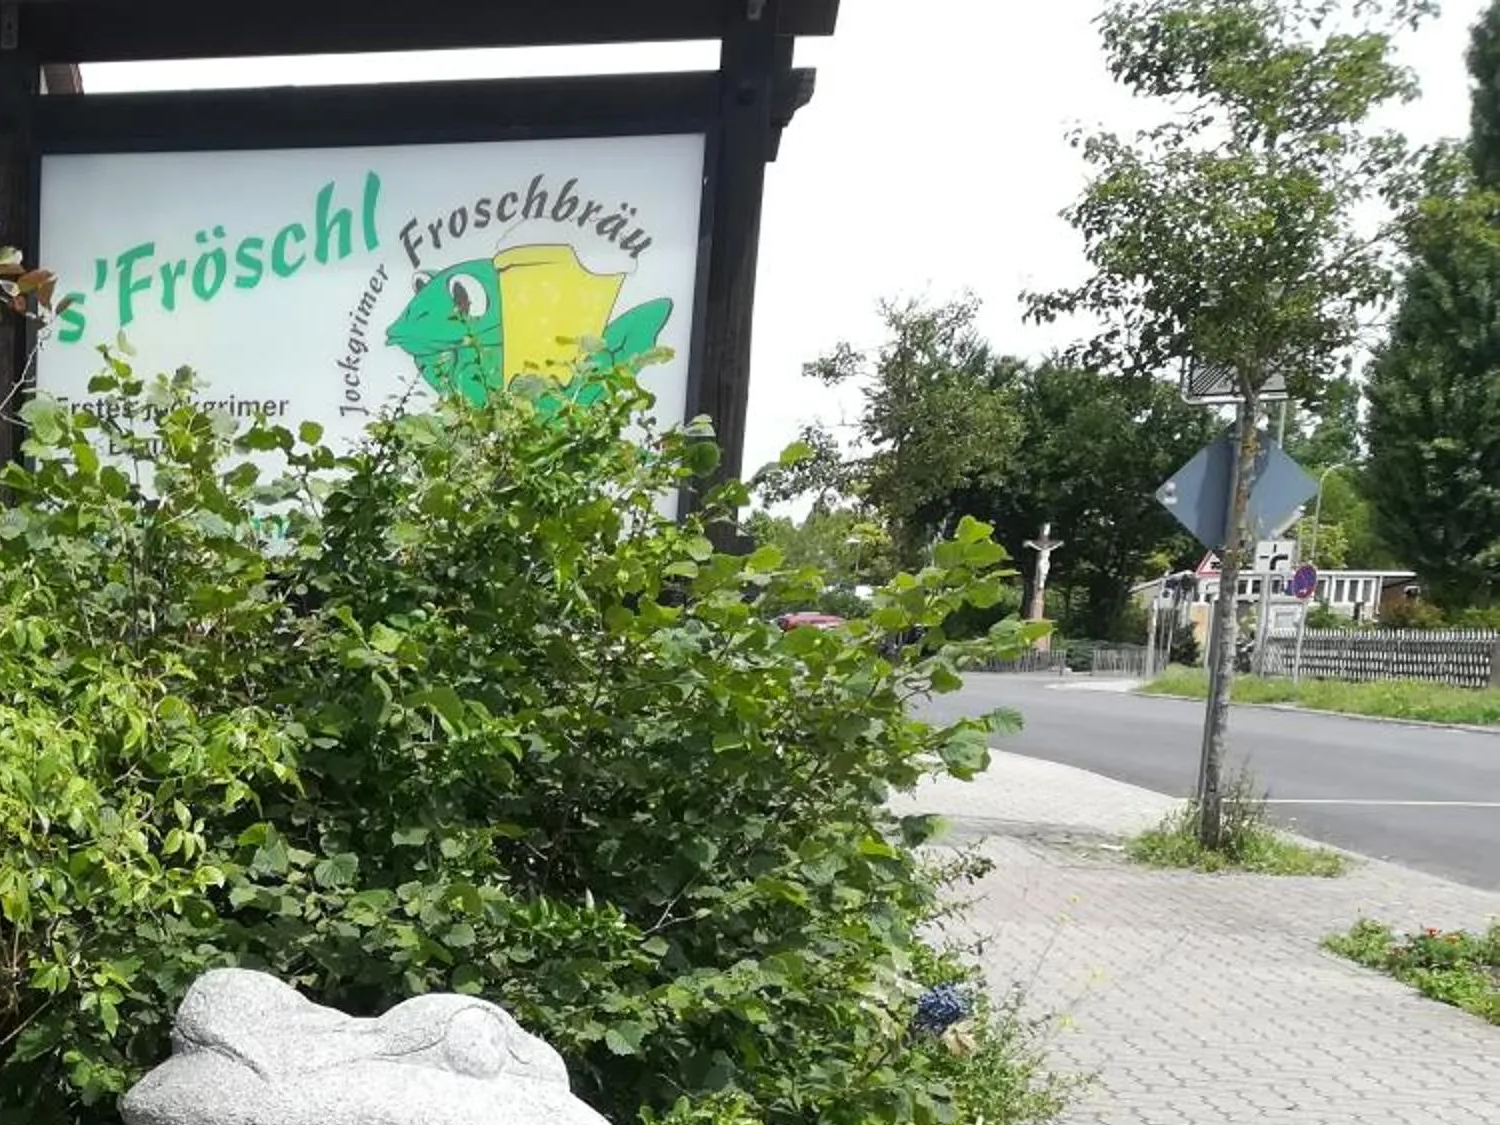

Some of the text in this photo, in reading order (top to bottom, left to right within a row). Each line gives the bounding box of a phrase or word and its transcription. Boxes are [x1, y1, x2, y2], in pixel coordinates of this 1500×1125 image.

[338, 173, 652, 417] Jockgrimer Froschbräu
[56, 395, 289, 422] rstes Jgrimer
